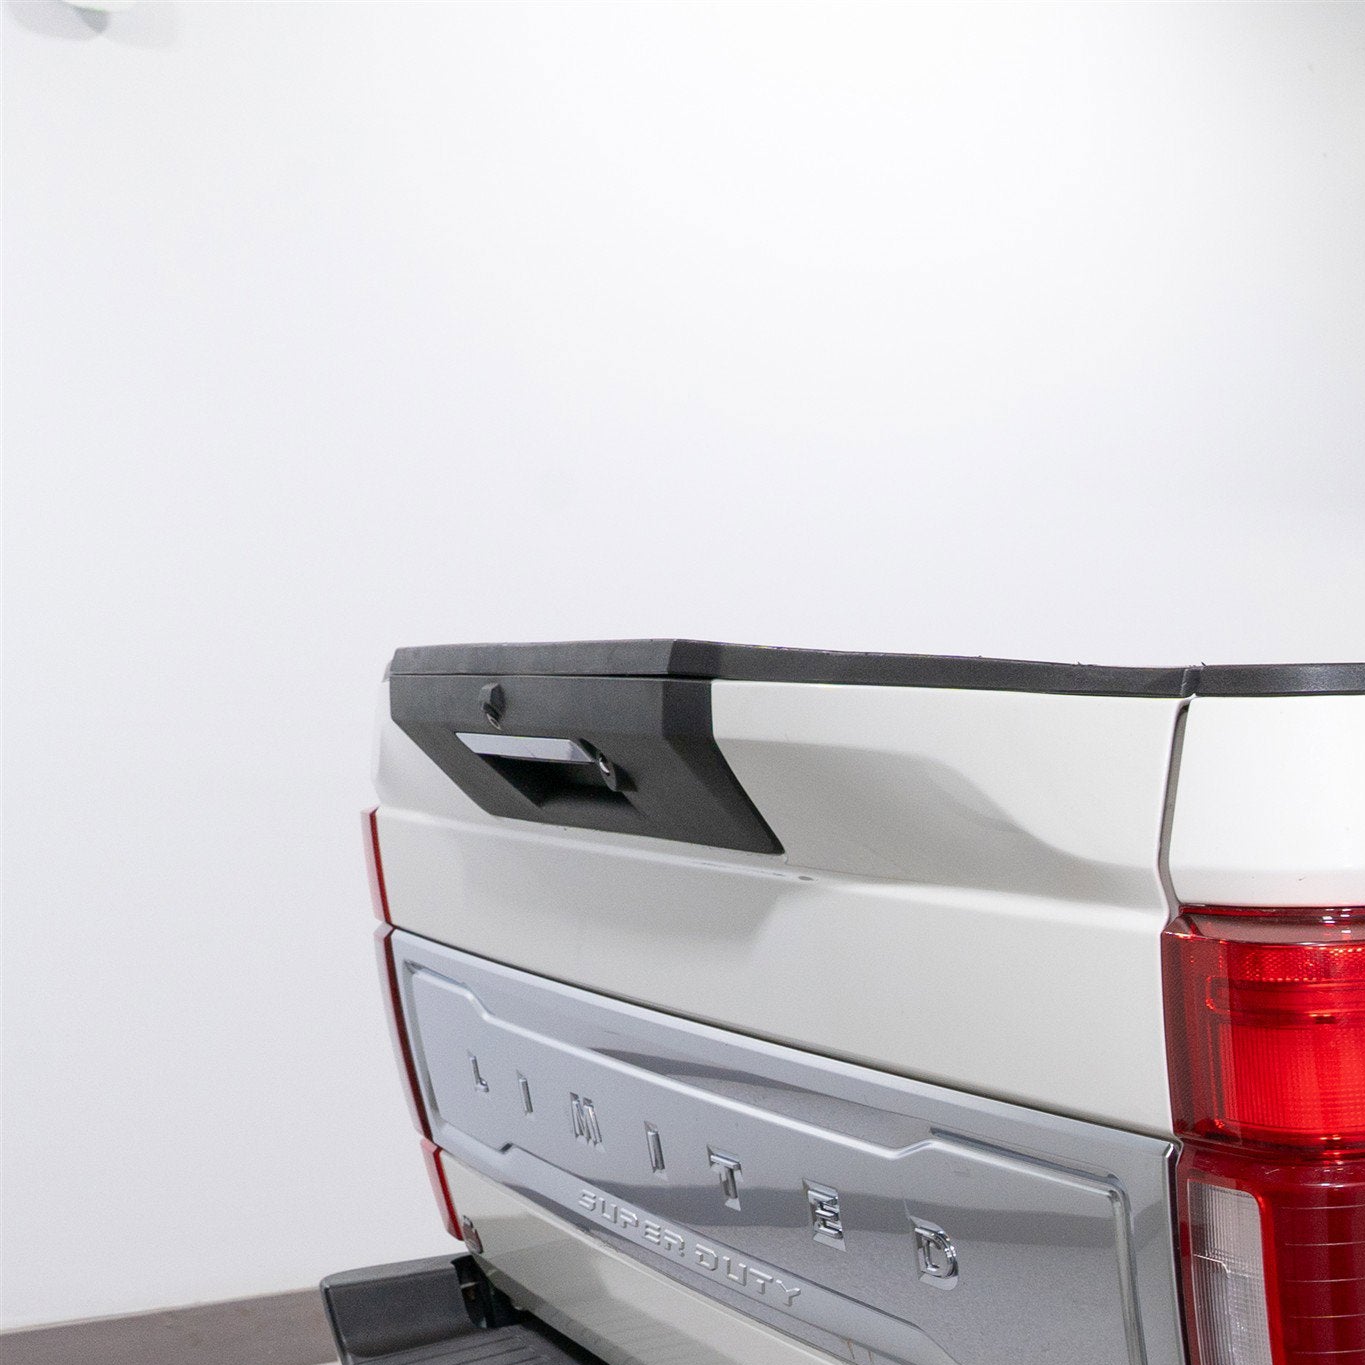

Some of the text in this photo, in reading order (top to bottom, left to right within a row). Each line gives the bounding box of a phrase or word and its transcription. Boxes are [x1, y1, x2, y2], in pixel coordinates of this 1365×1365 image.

[467, 1050, 959, 1288] LIMITED
[578, 1188, 801, 1307] SUPER DUTY
